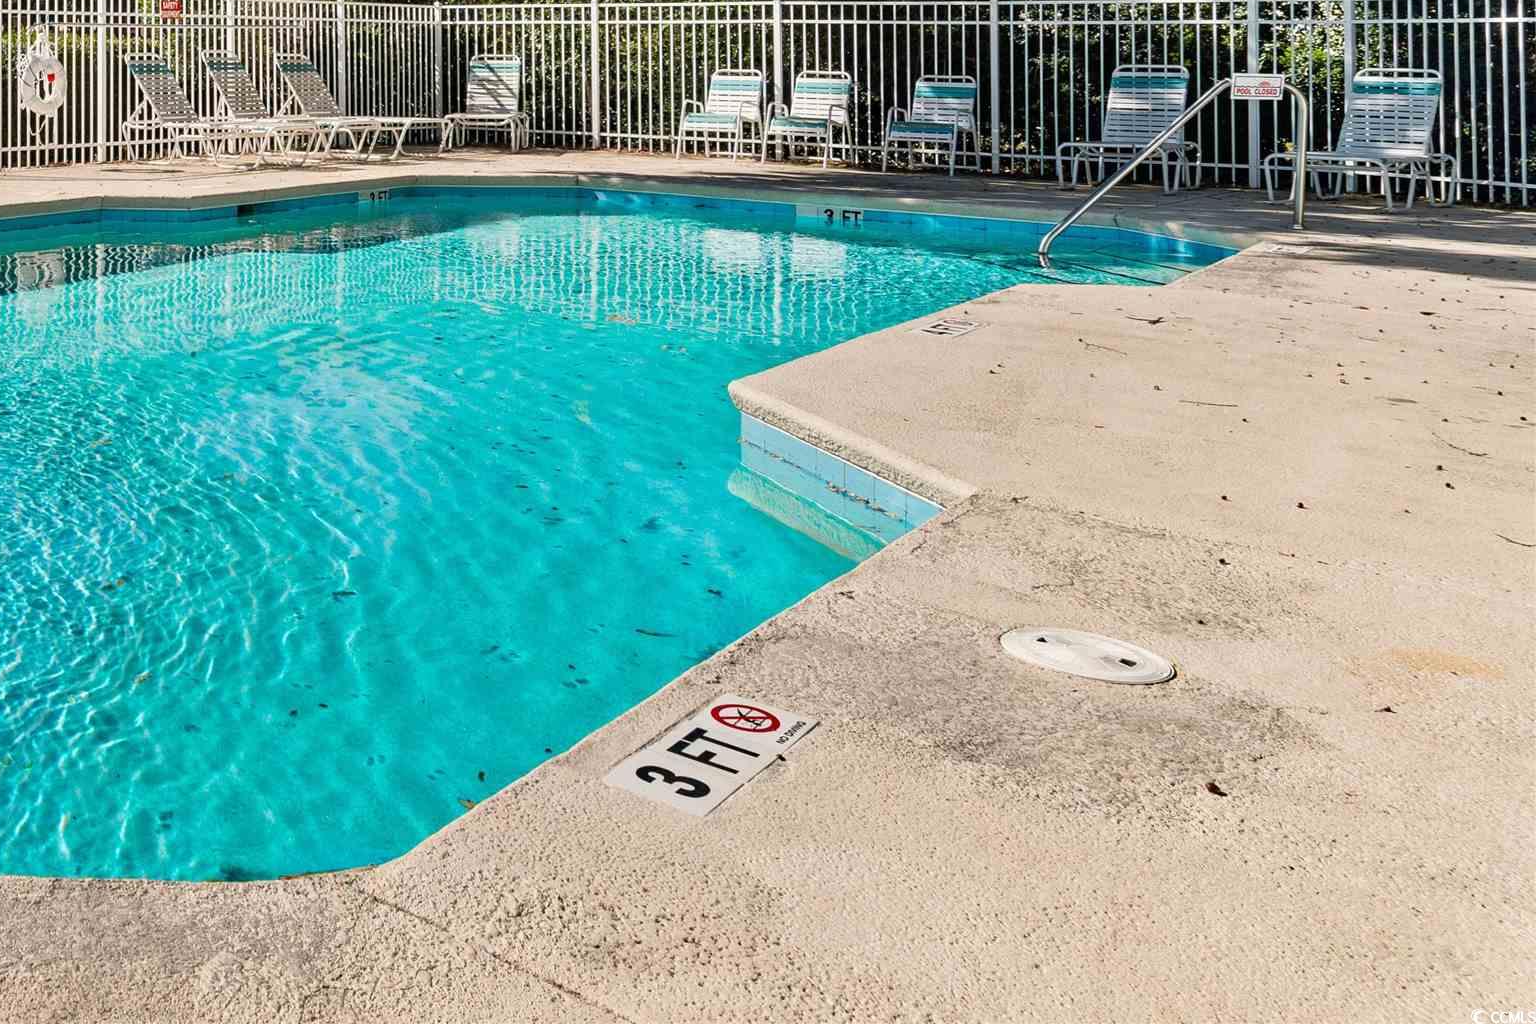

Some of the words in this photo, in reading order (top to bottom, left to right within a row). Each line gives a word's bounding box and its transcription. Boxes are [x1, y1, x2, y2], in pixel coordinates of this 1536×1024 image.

[1236, 87, 1252, 95] POOL
[842, 209, 862, 223] FT
[666, 727, 761, 775] FT
[635, 765, 711, 799] 3
